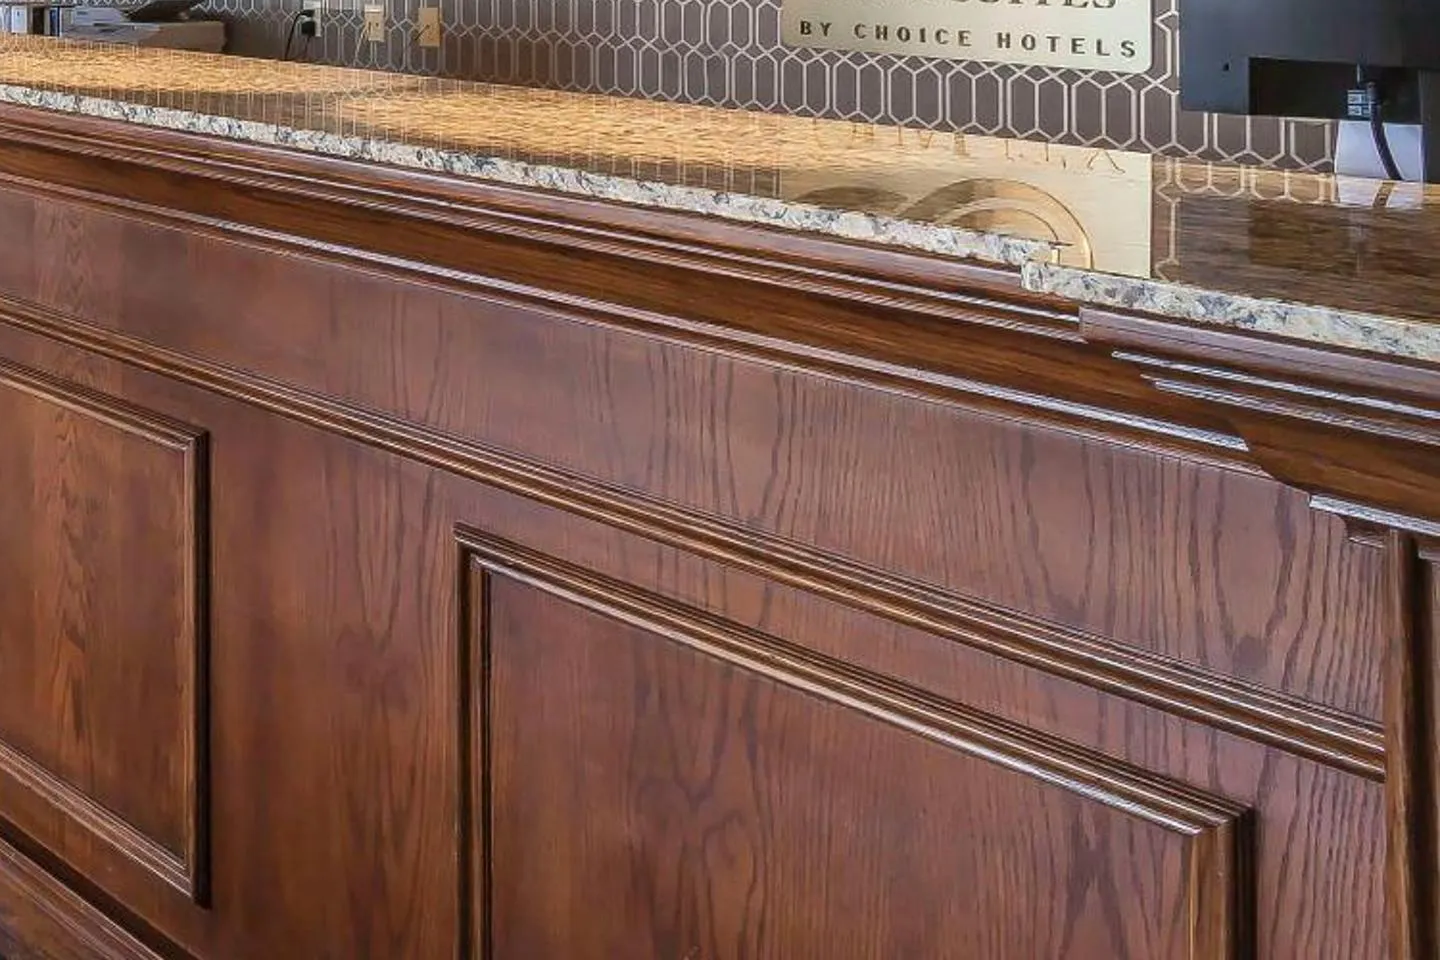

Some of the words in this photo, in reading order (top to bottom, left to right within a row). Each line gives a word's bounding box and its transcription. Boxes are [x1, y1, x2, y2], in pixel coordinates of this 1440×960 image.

[799, 20, 833, 37] BY
[854, 24, 972, 47] CHOICE
[997, 31, 1137, 59] HOTELS
